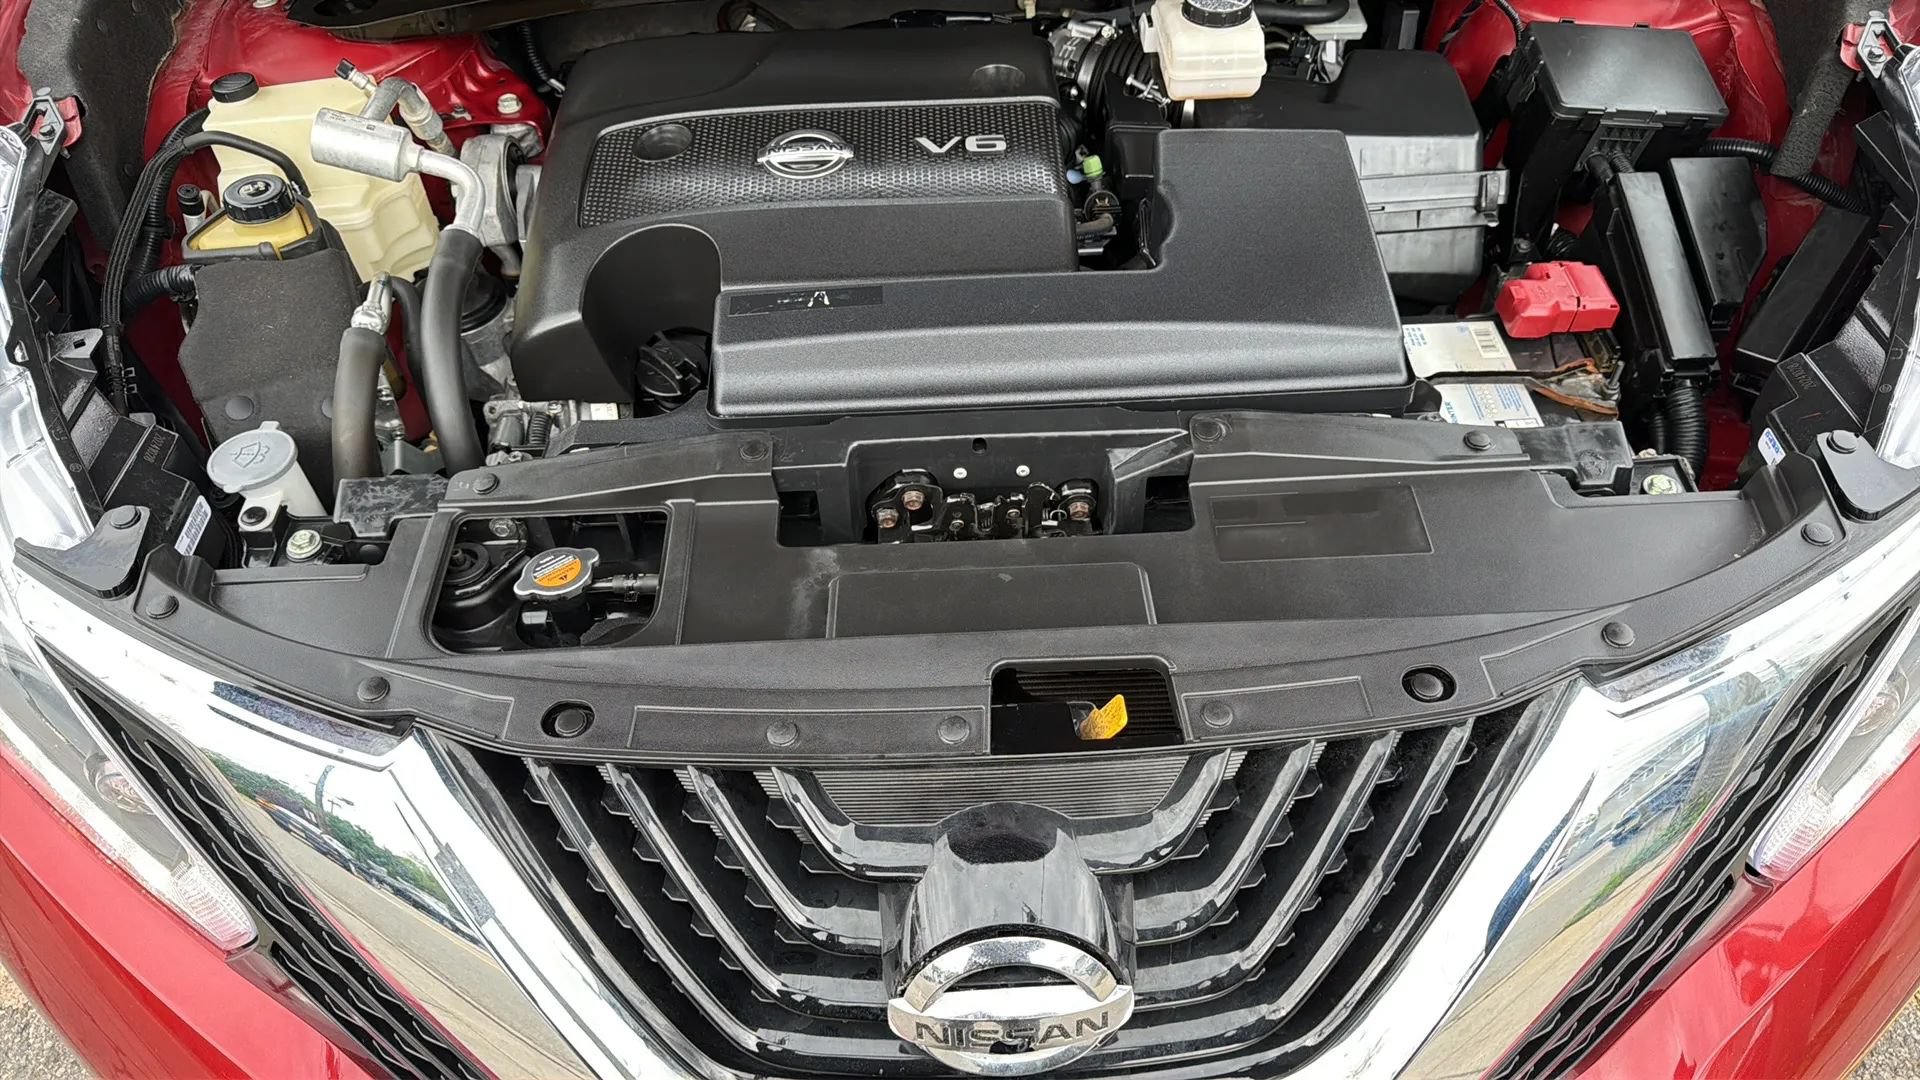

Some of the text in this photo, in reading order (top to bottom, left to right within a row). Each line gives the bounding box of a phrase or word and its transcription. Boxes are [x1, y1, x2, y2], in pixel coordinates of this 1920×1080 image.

[767, 143, 844, 155] NISSAN
[915, 134, 1007, 153] V6
[915, 1011, 1109, 1046] NISSAN
